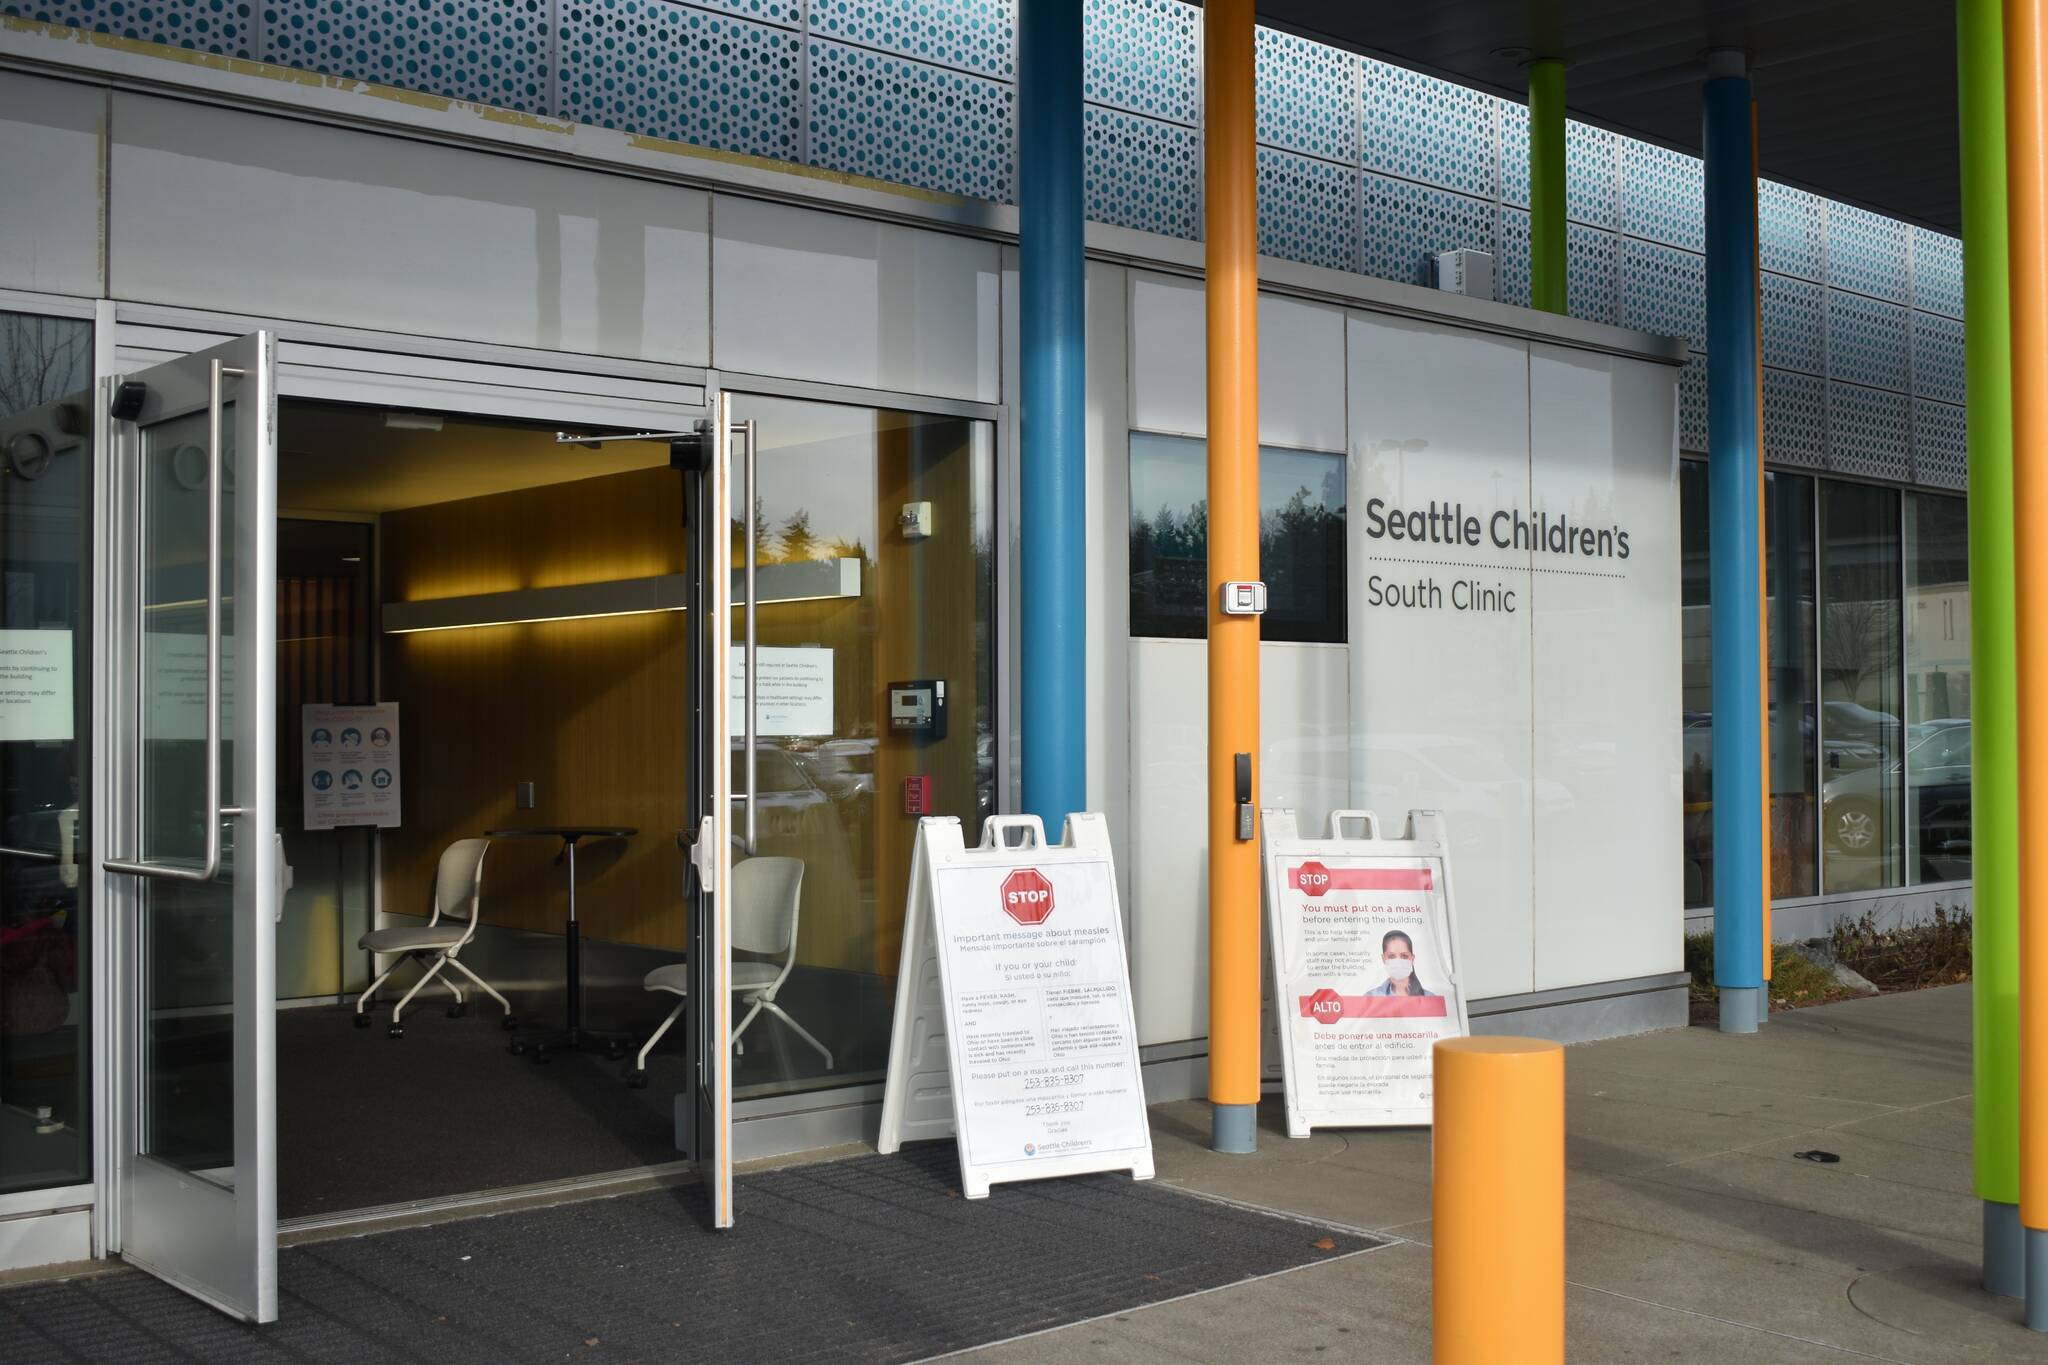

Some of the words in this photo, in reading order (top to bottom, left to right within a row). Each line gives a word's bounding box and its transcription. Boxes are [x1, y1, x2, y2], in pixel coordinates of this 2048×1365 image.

[1366, 498, 1481, 546] Seattle
[1489, 510, 1630, 560] Children's
[1368, 575, 1442, 609] South
[1452, 580, 1515, 613] Clinic
[1300, 874, 1328, 885] STOP
[1008, 890, 1049, 904] STOP
[1302, 904, 1320, 913] You
[1324, 904, 1348, 913] must
[1352, 905, 1369, 915] put
[1396, 904, 1422, 913] mask
[1302, 915, 1331, 924] before
[1333, 916, 1370, 926] entering
[1372, 916, 1385, 924] the
[1388, 916, 1425, 926] building.
[954, 931, 1000, 944] Important
[1003, 931, 1042, 943] message
[1046, 928, 1072, 938] about
[1074, 927, 1109, 937] measles
[960, 944, 990, 953] Mensaje
[993, 941, 1034, 951] importante
[1037, 940, 1057, 948] sobre
[995, 963, 1001, 971] If
[1004, 964, 1020, 973] you
[1033, 962, 1052, 971] your
[1014, 972, 1034, 980] usted
[1313, 1001, 1341, 1013] ALTO
[1314, 1032, 1336, 1040] Debe
[1338, 1033, 1374, 1043] ponerse
[1394, 1031, 1438, 1039] mascarilla
[1337, 1042, 1348, 1050] de
[1349, 1042, 1373, 1050] entrar
[1384, 1041, 1416, 1050] edificio.
[971, 1071, 995, 1080] Please
[997, 1071, 1010, 1079] put
[1030, 1067, 1048, 1075] mask
[1051, 1066, 1064, 1074] and
[1067, 1064, 1079, 1072] call
[1081, 1063, 1094, 1071] this
[1024, 1074, 1084, 1090] 253-835-8307
[1025, 1101, 1084, 1117] 253-835-8307
[1038, 1142, 1060, 1151] Seattle
